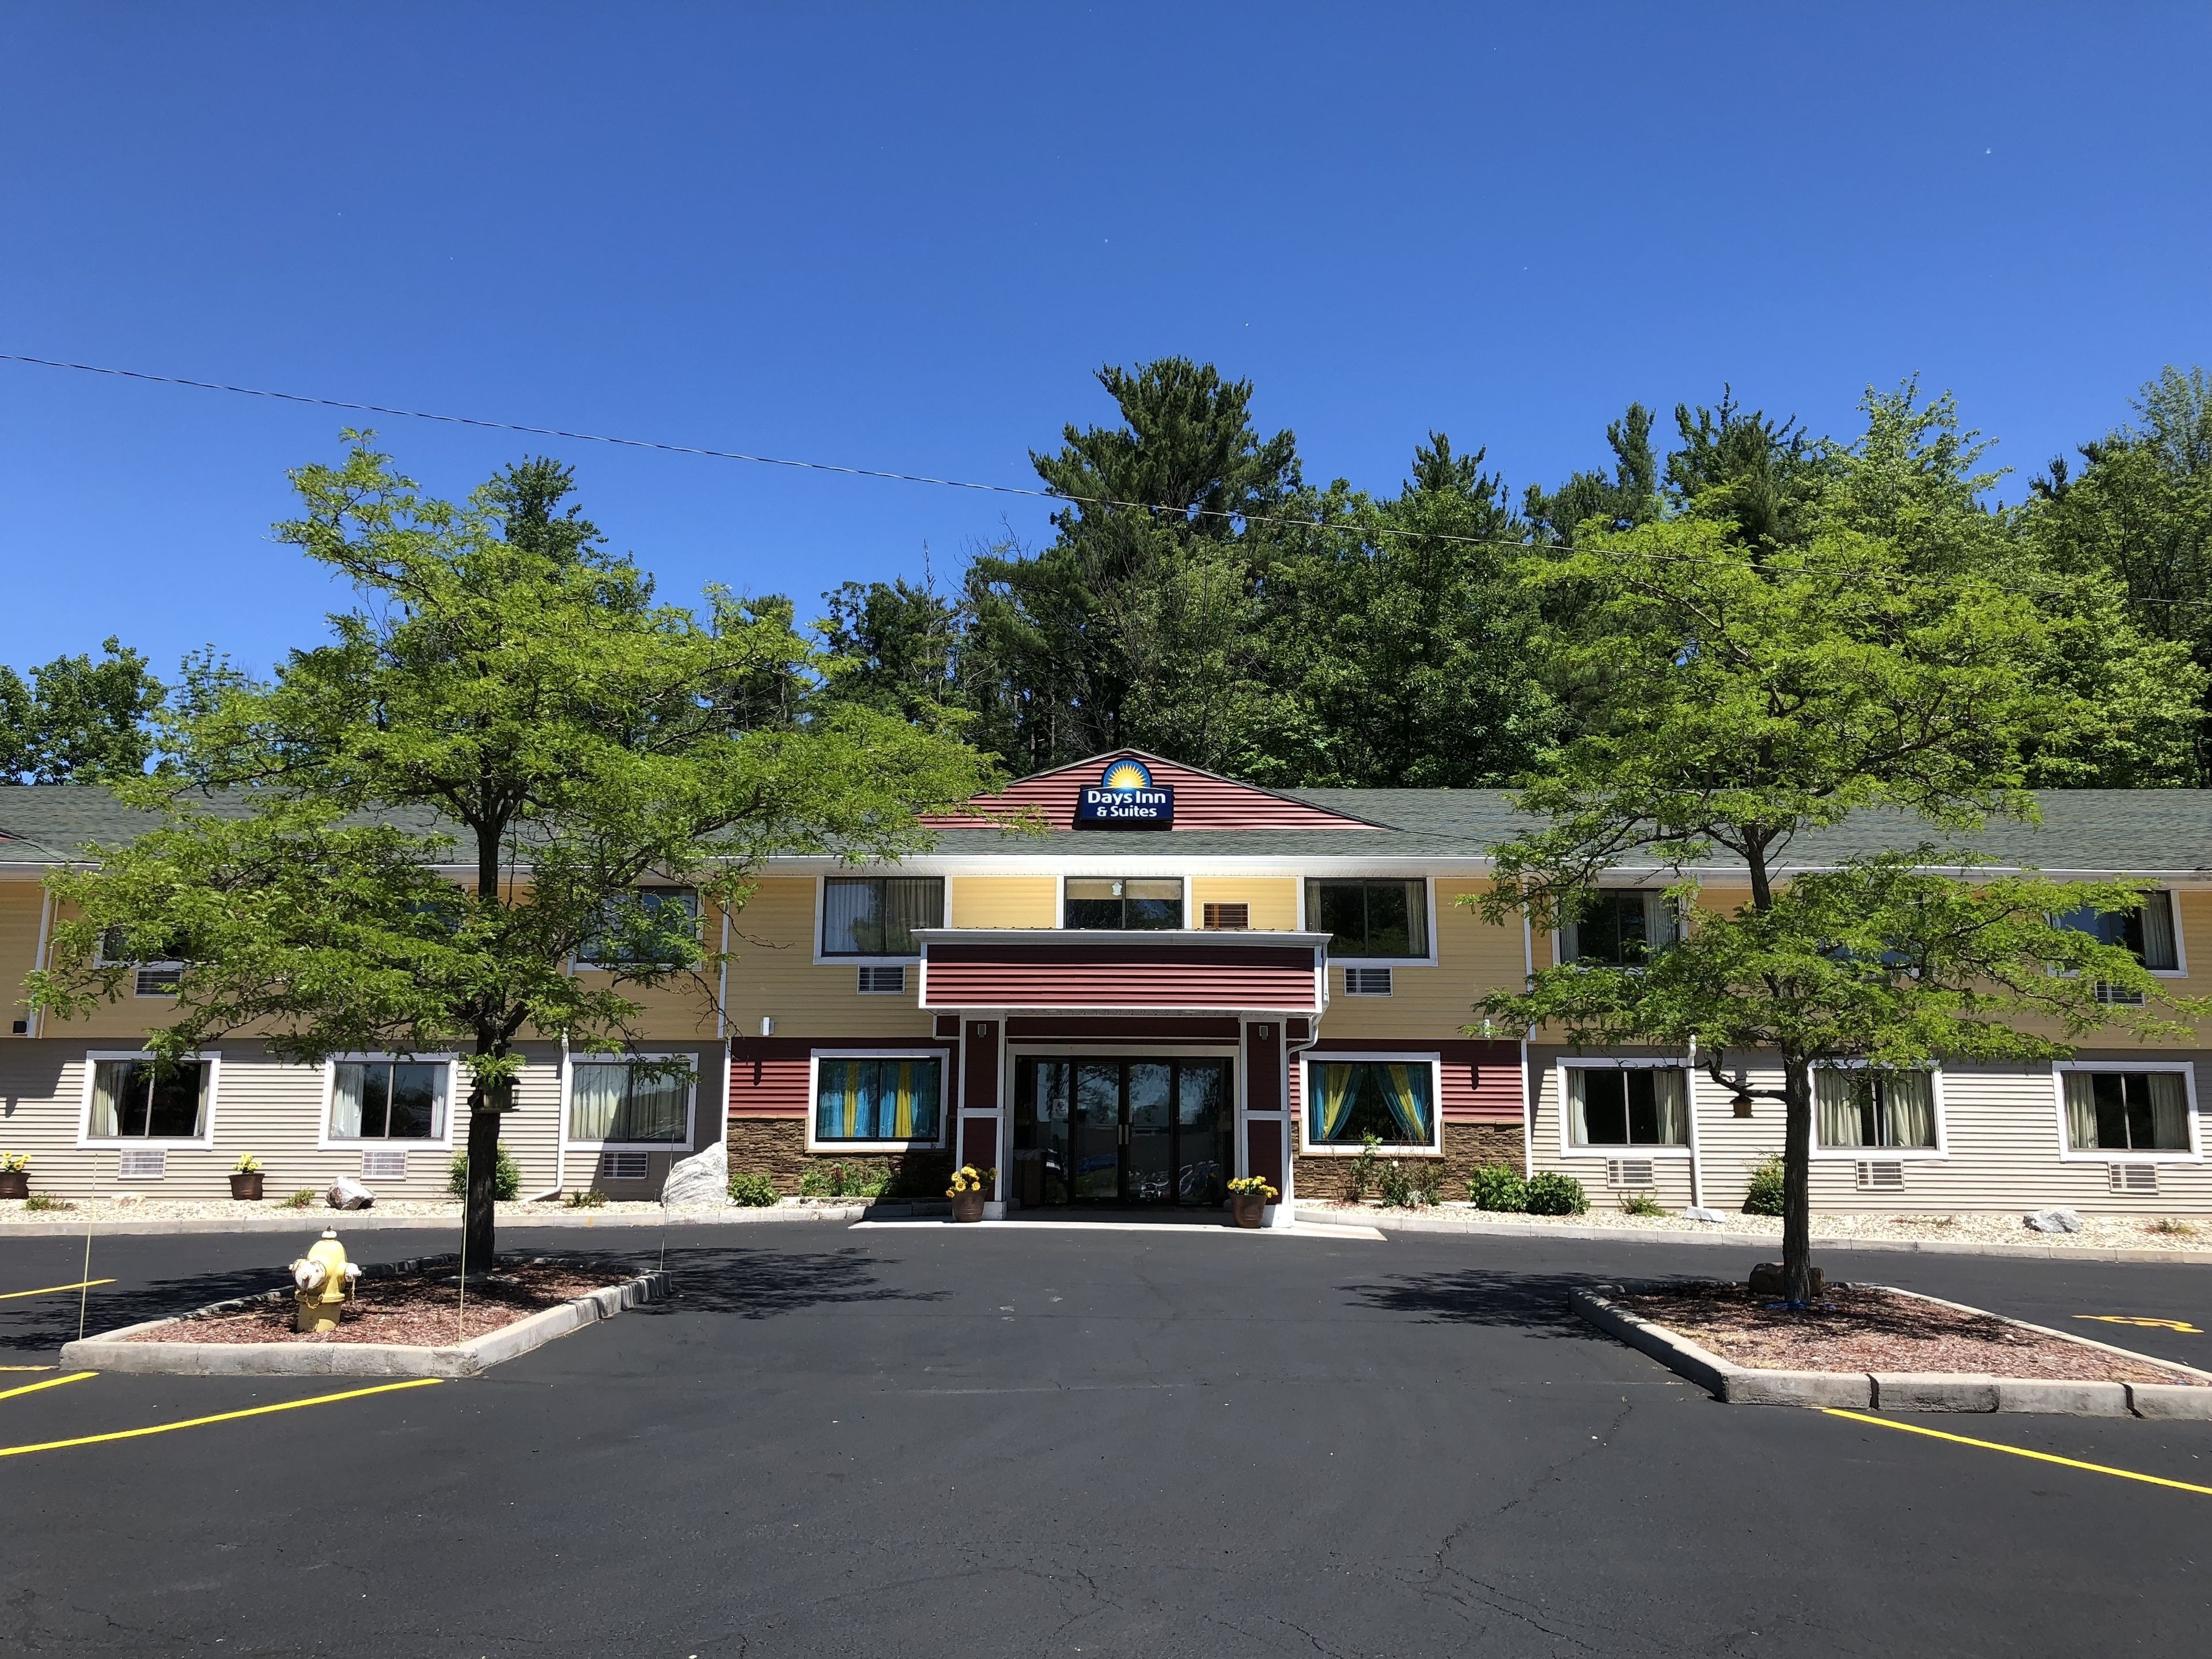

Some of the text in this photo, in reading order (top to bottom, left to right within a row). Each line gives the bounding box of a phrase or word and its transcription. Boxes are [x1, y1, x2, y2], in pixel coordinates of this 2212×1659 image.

[1088, 790, 1166, 805] Days Inn
[1097, 805, 1157, 817] & Suites
